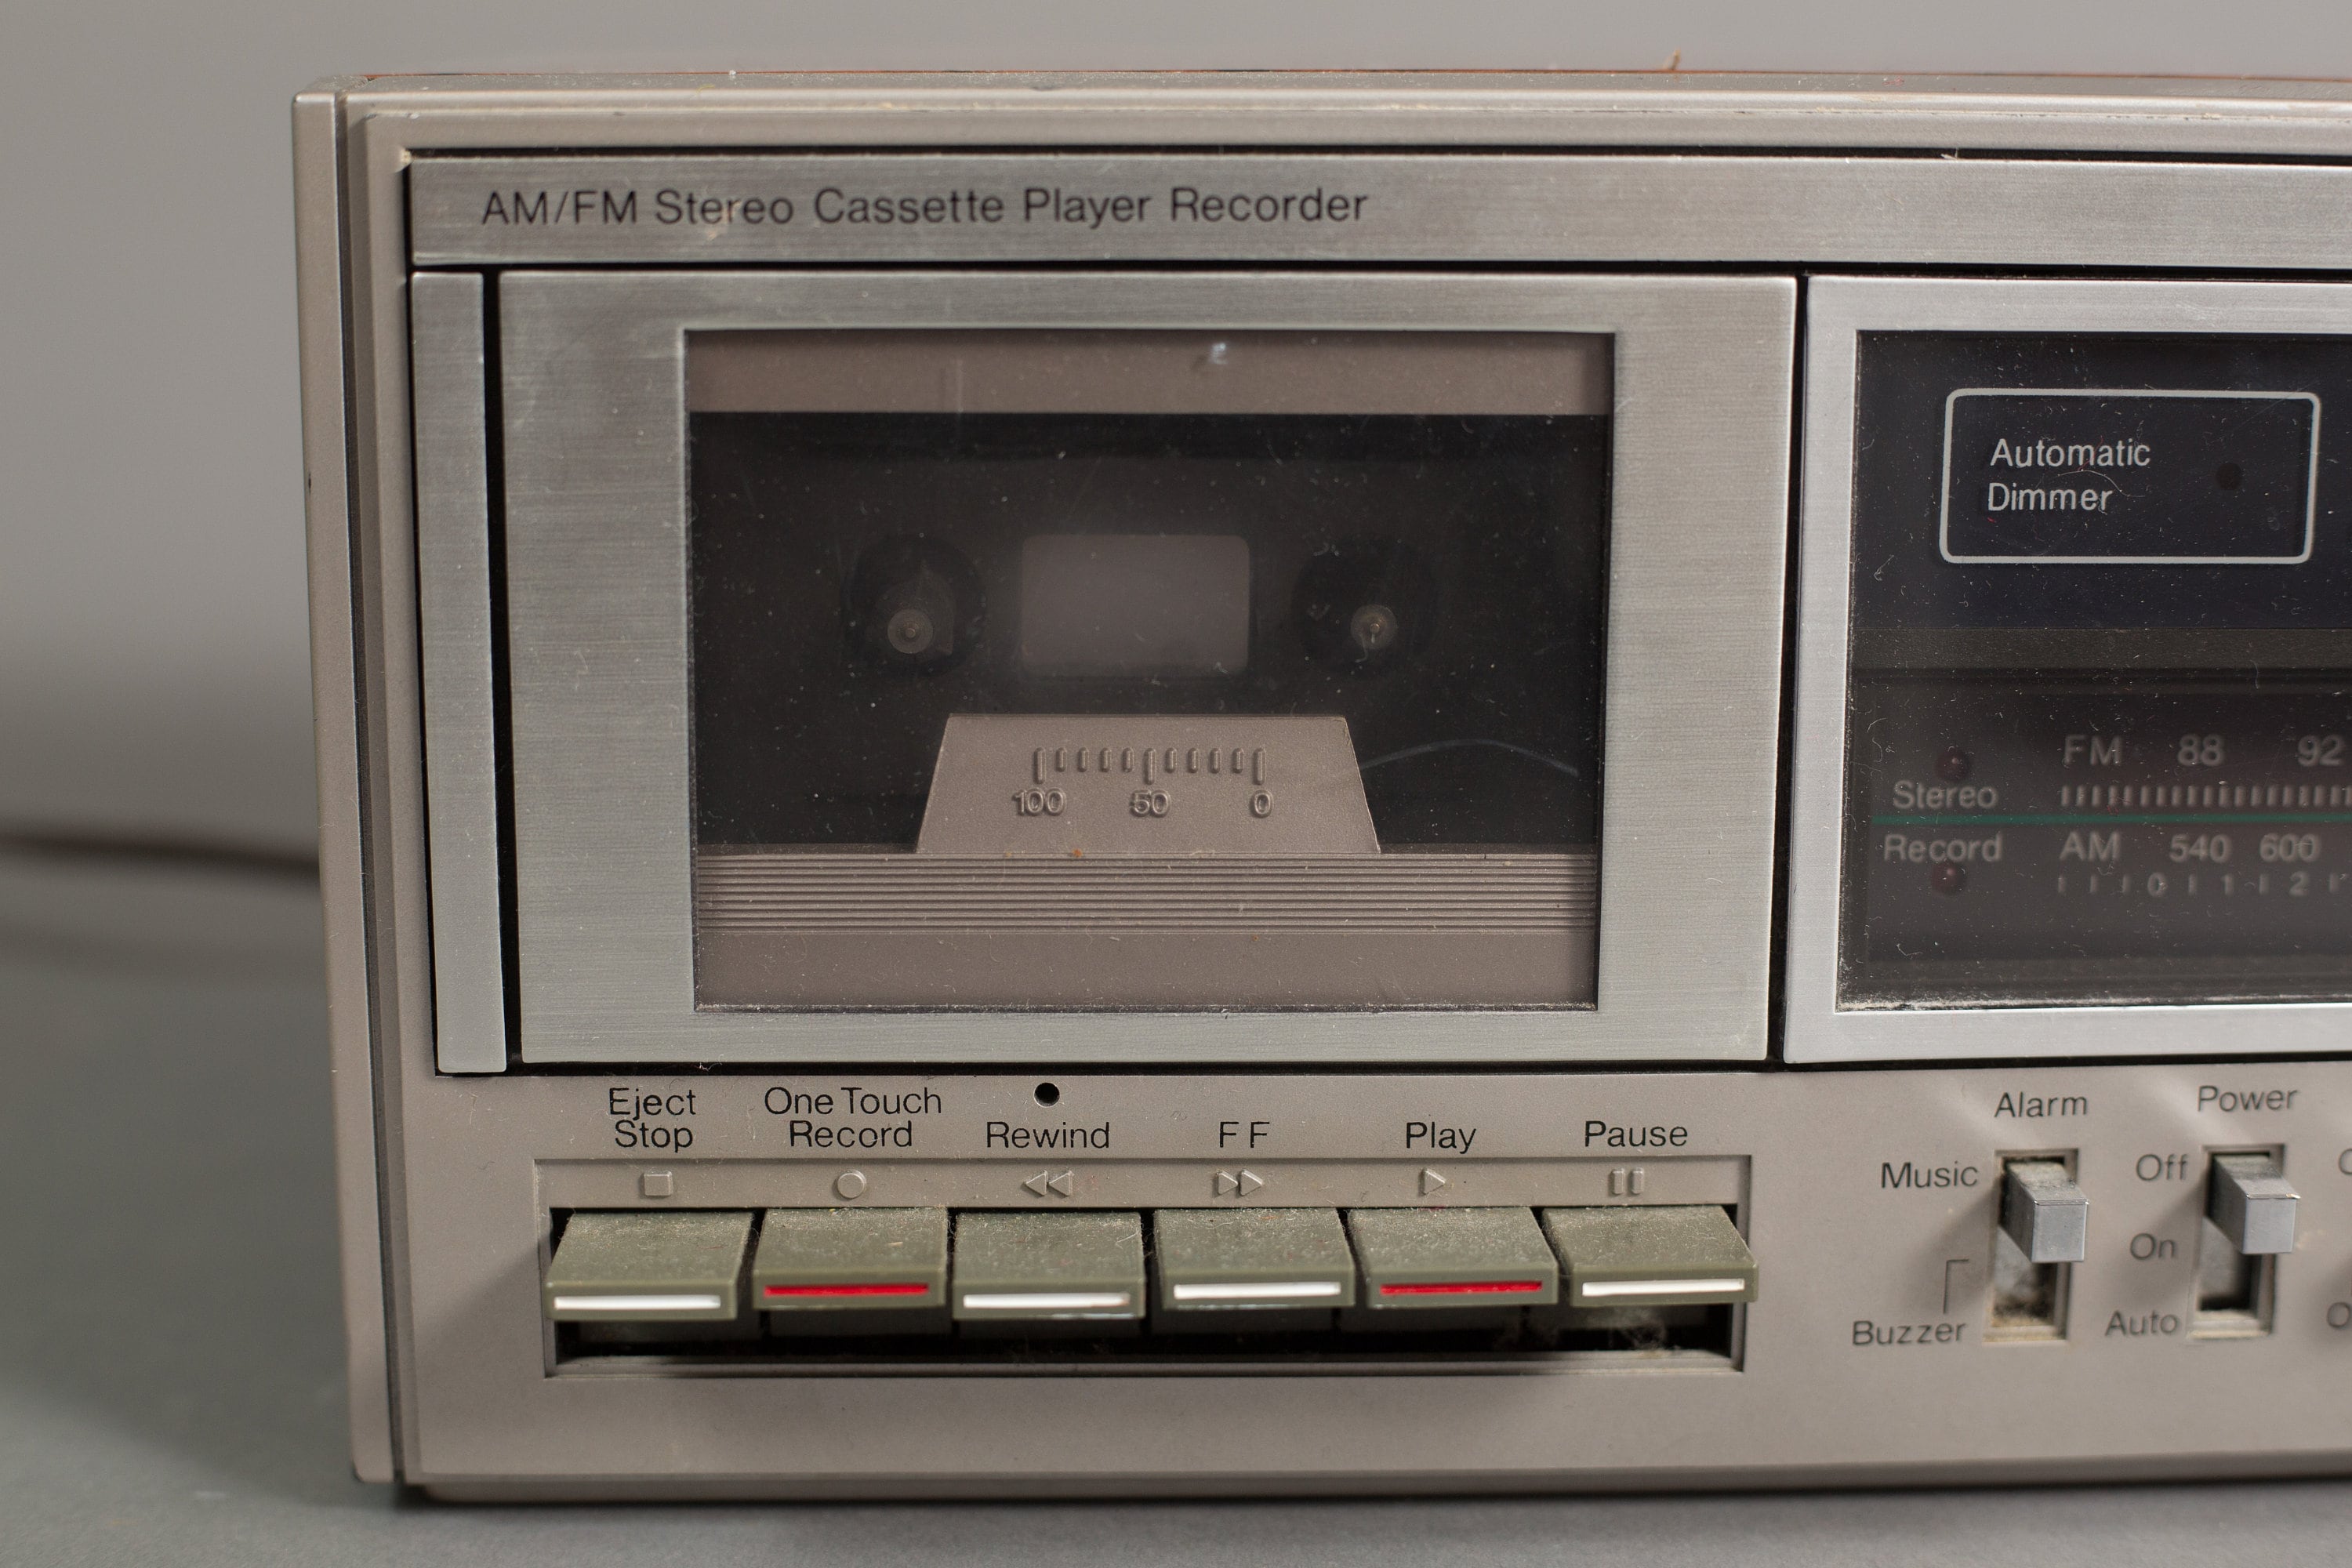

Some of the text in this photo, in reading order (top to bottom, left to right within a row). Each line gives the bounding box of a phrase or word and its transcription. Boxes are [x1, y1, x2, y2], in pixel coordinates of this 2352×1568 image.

[481, 187, 1370, 229] AM/FM Stereo Cassette Player Recorder
[1990, 437, 2151, 467] Automatic
[1987, 482, 2114, 512] Dimmer
[2062, 734, 2344, 768] FM 88 92
[1016, 787, 1274, 818] 100 50 0
[1891, 779, 1999, 811] Stereo
[1883, 833, 2003, 863] Record
[2059, 831, 2321, 862] AM 540 600
[2147, 872, 2165, 898] 0
[2288, 871, 2308, 898] 2
[609, 1087, 697, 1122] Eject
[764, 1087, 942, 1115] One Touch
[1994, 1092, 2089, 1119] Alarm
[2198, 1085, 2300, 1113] Power
[614, 1120, 694, 1154] Stop
[789, 1120, 913, 1148] Record
[985, 1121, 1110, 1149] Rewind
[1405, 1121, 1477, 1155] Play
[1584, 1120, 1689, 1149] Pause
[1882, 1160, 1980, 1189] Music
[2136, 1152, 2190, 1182] Off
[2130, 1232, 2176, 1260] On
[1852, 1319, 1968, 1347] Buzzer
[2105, 1309, 2180, 1337] Auto
